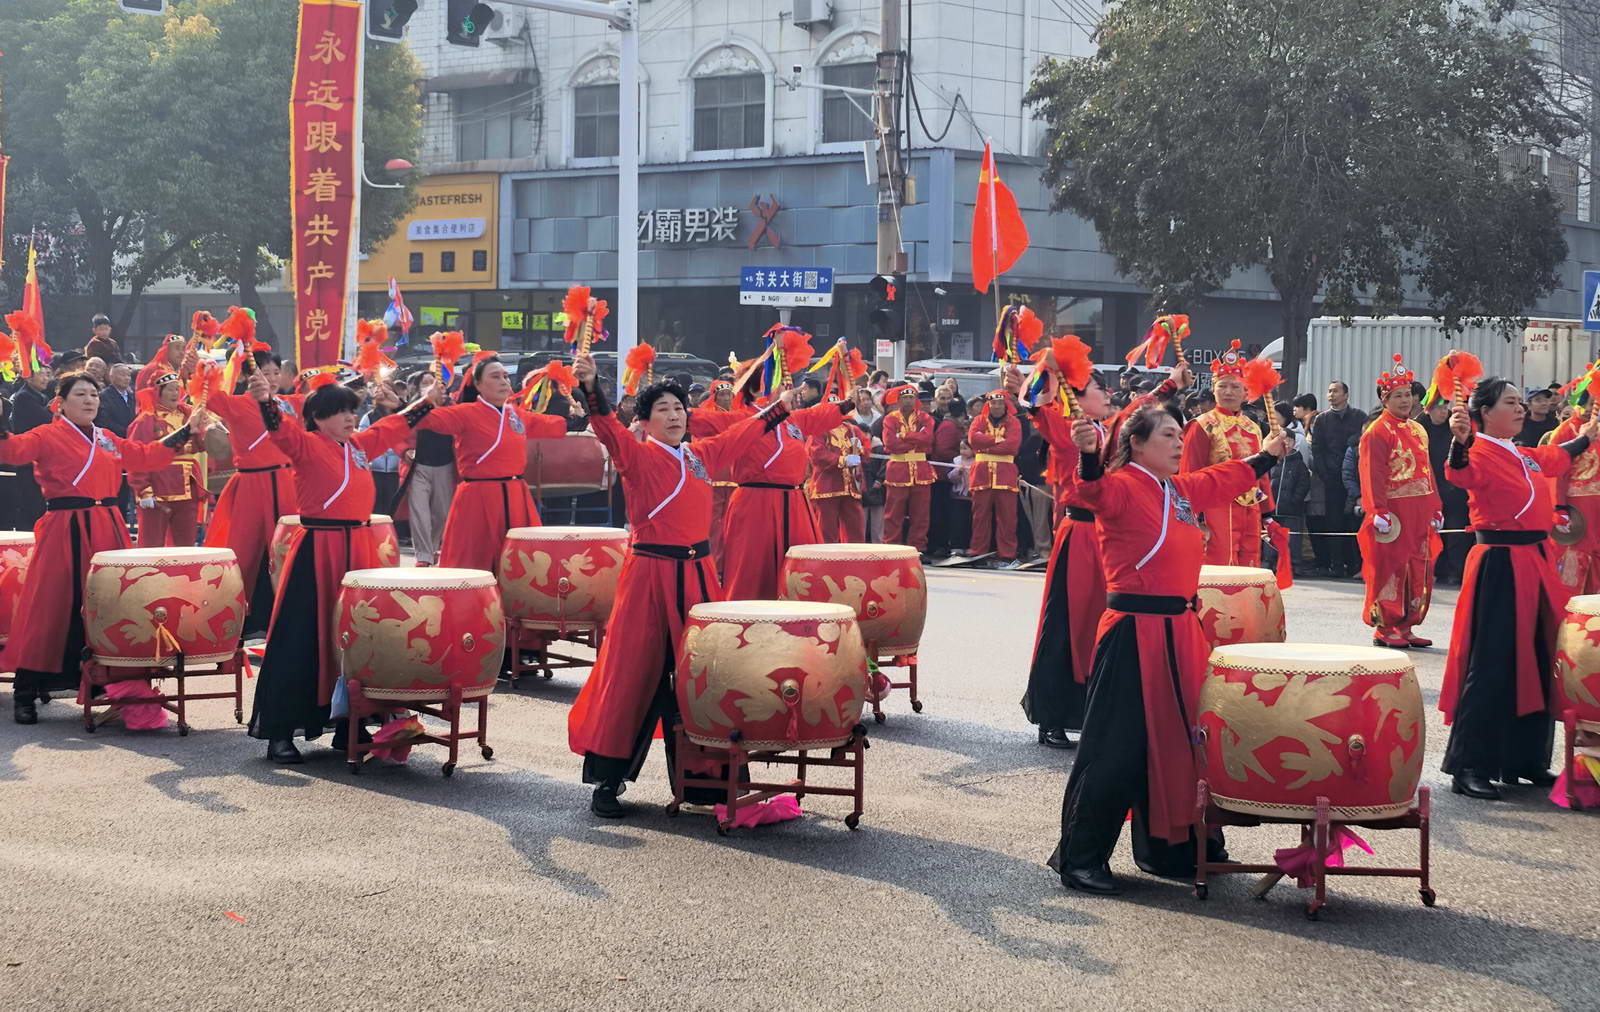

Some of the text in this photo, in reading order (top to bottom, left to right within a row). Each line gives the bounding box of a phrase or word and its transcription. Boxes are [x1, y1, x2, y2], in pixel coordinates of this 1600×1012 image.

[303, 30, 346, 341] 永远跟着共产党
[755, 270, 802, 288] 东关大街
[1530, 333, 1548, 342] JAC
